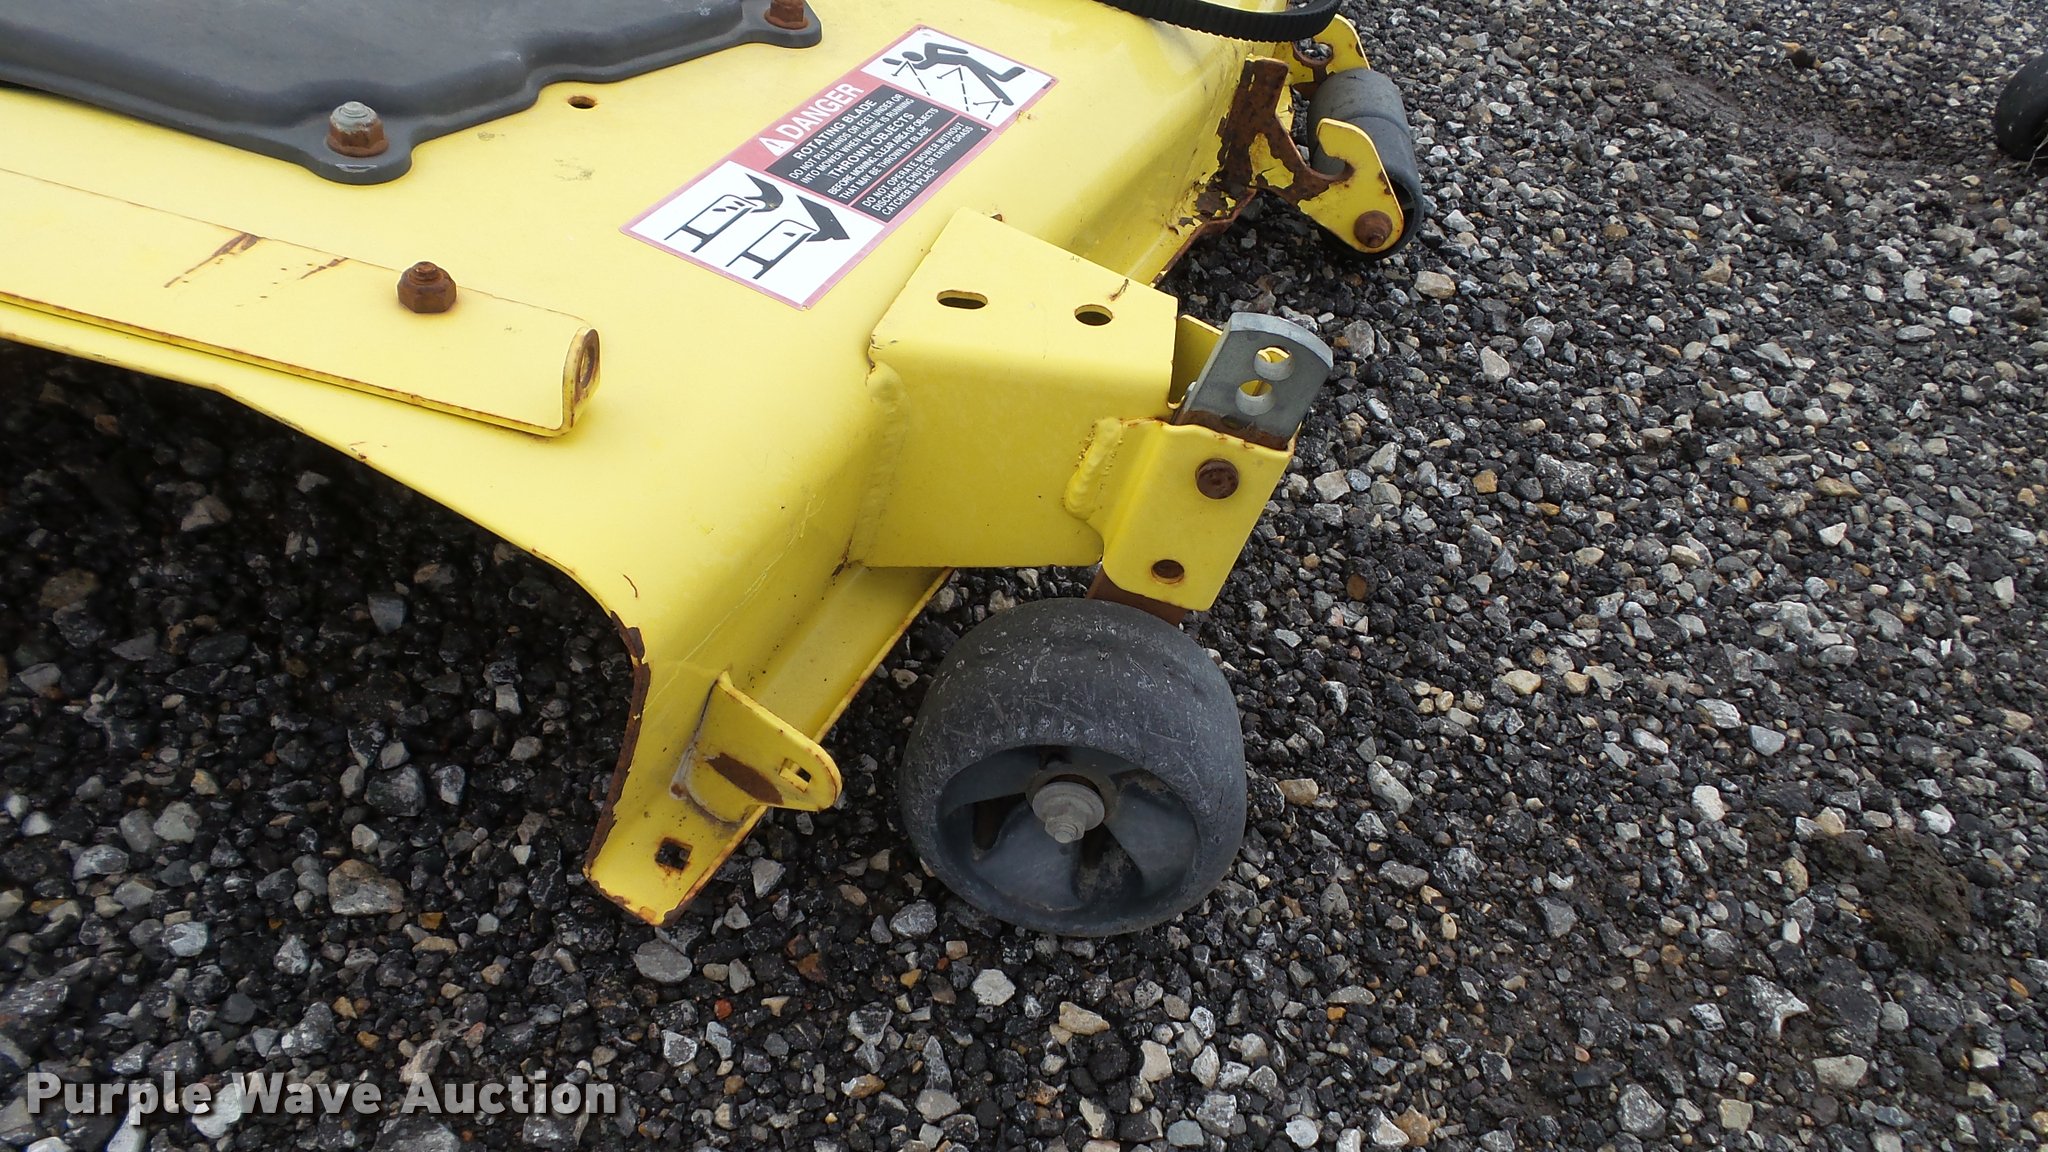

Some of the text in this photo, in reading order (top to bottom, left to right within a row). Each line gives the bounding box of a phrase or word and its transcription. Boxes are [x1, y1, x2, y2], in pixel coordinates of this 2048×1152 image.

[776, 83, 864, 140] DANGER
[788, 93, 904, 179] DO NOT PUT HANDS OR FEET UNDER OR
[792, 99, 877, 160] ROTATING BLADE
[827, 112, 914, 177] THROWN OBJECTS
[800, 170, 820, 184] INTO
[816, 151, 845, 171] MOWER
[839, 137, 862, 153] WHEN
[858, 120, 884, 139] ENGINE
[827, 174, 856, 195] BEFORE
[874, 141, 896, 157] CLEAR
[892, 131, 910, 144] AREA
[905, 124, 916, 133] OF
[912, 107, 939, 127] OBJECTS
[838, 126, 932, 199] THAT MAY BE THROWN BY BLADE
[862, 122, 964, 207] DO NOT OPERATE MOWER WITHOUT
[871, 125, 974, 211] DISCHARGE CHUTE OR ENTIRE GRASS
[882, 167, 938, 215] CATCHER IN PLACE
